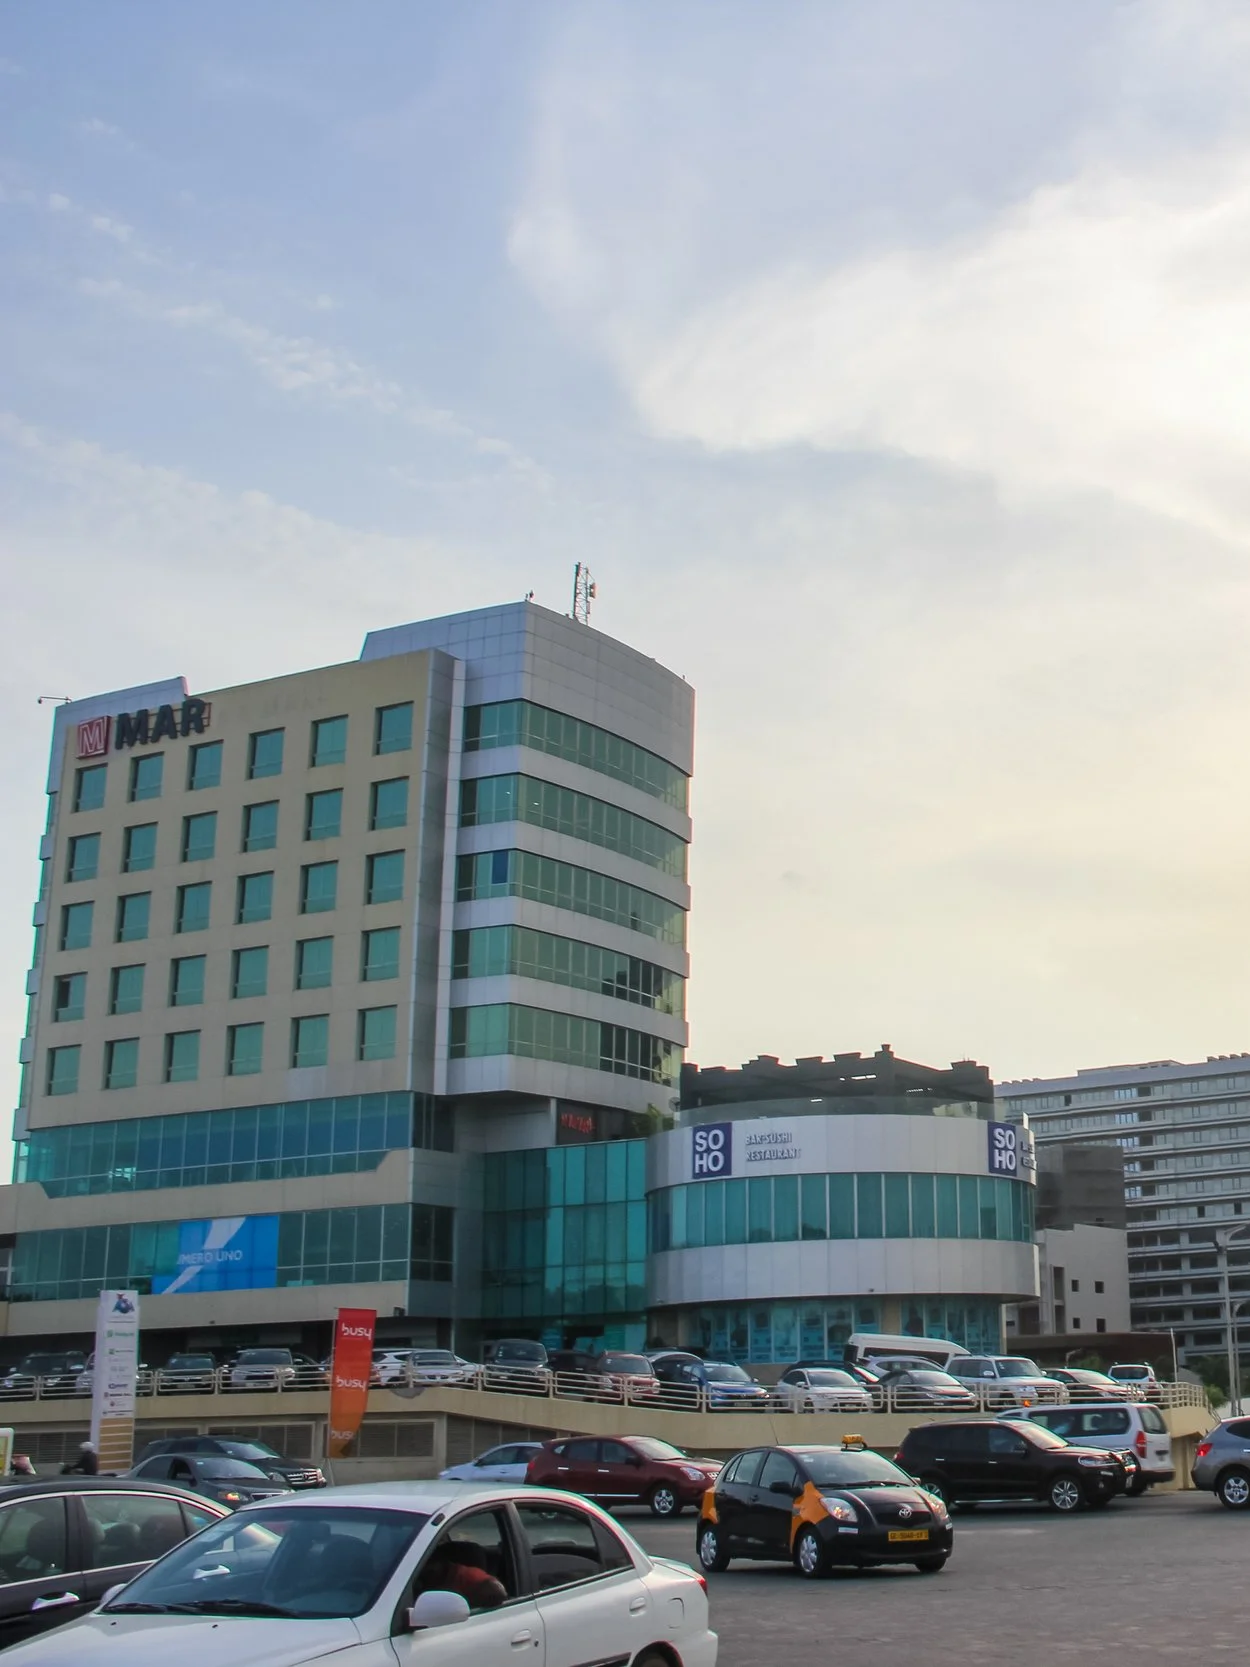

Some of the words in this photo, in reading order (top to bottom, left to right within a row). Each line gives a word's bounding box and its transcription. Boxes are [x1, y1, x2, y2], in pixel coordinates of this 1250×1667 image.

[115, 699, 205, 750] MAR
[695, 1129, 724, 1152] SO
[993, 1128, 1015, 1150] SO
[694, 1151, 724, 1174] HO
[994, 1149, 1016, 1170] HO
[216, 1249, 243, 1262] UNO
[341, 1322, 373, 1341] busy
[336, 1375, 368, 1392] busy
